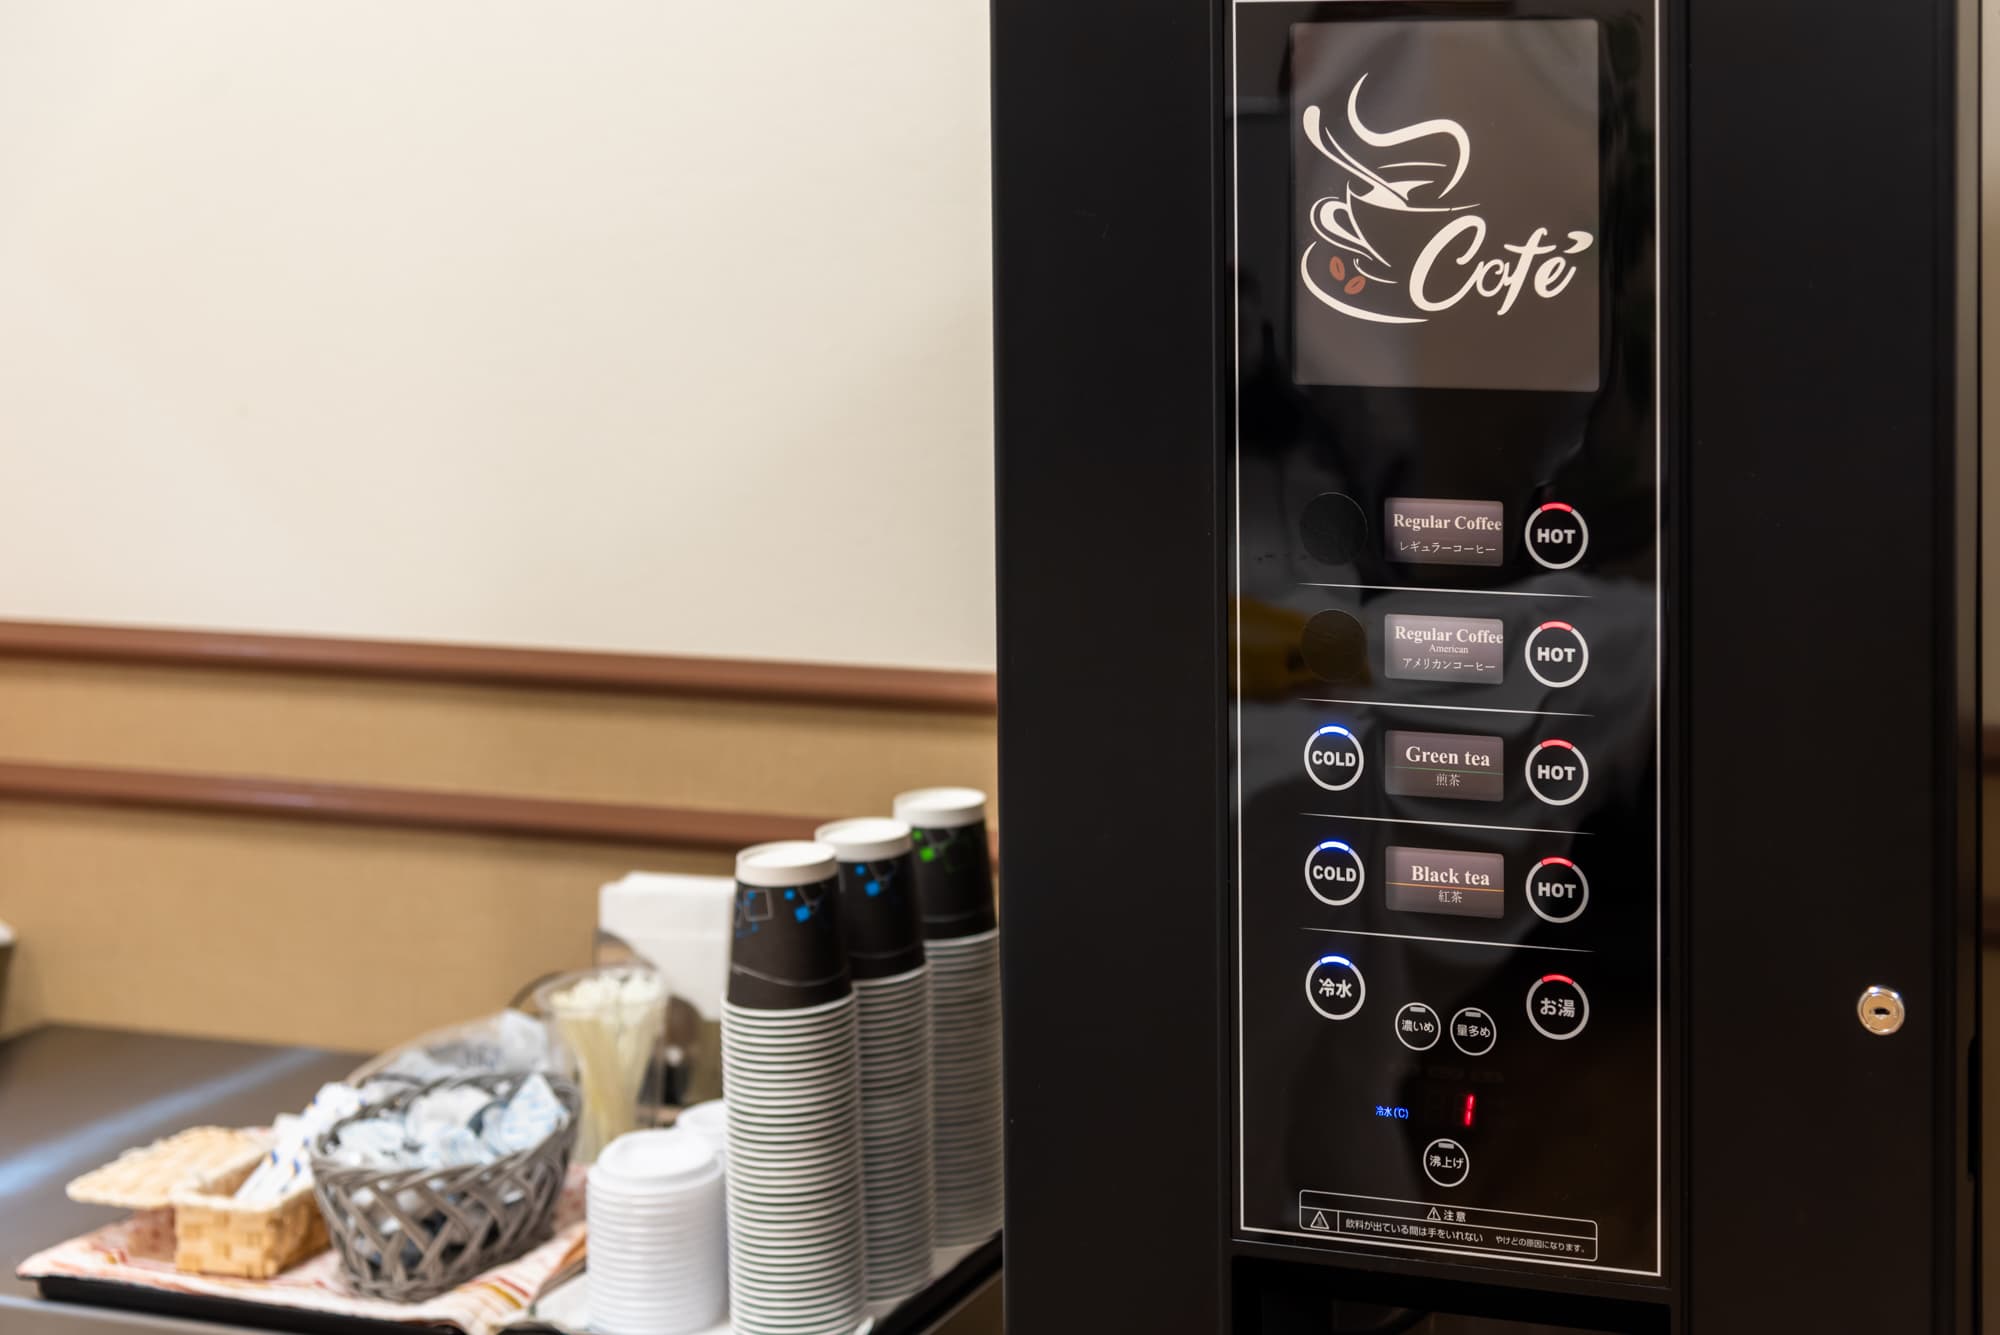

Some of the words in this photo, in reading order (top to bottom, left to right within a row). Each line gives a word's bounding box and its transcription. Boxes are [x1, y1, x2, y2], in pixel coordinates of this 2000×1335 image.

[1393, 513, 1450, 532] Regular
[1454, 515, 1502, 532] Coffee
[1537, 528, 1576, 545] HOT
[1399, 540, 1497, 555] レギュラーコーヒー
[1395, 625, 1452, 643] Regular
[1456, 628, 1503, 645] Coffee
[1428, 643, 1469, 655] American
[1537, 647, 1576, 663] HOT
[1402, 657, 1496, 672] アメリカンコーヒー
[1312, 750, 1356, 768] COLD
[1405, 746, 1459, 765] Green
[1464, 750, 1491, 767] tea
[1435, 772, 1461, 788] 煎茶
[1537, 765, 1576, 782] HOT
[1313, 865, 1357, 883] COLD
[1411, 865, 1461, 885] Black
[1464, 870, 1491, 886] tea
[1438, 889, 1463, 905] 紅茶
[1538, 882, 1577, 899] HOT
[1318, 978, 1353, 999] 冷水
[1539, 997, 1576, 1019] お湯
[1401, 1019, 1435, 1034] 濃いめ
[1443, 1208, 1467, 1224] 注意
